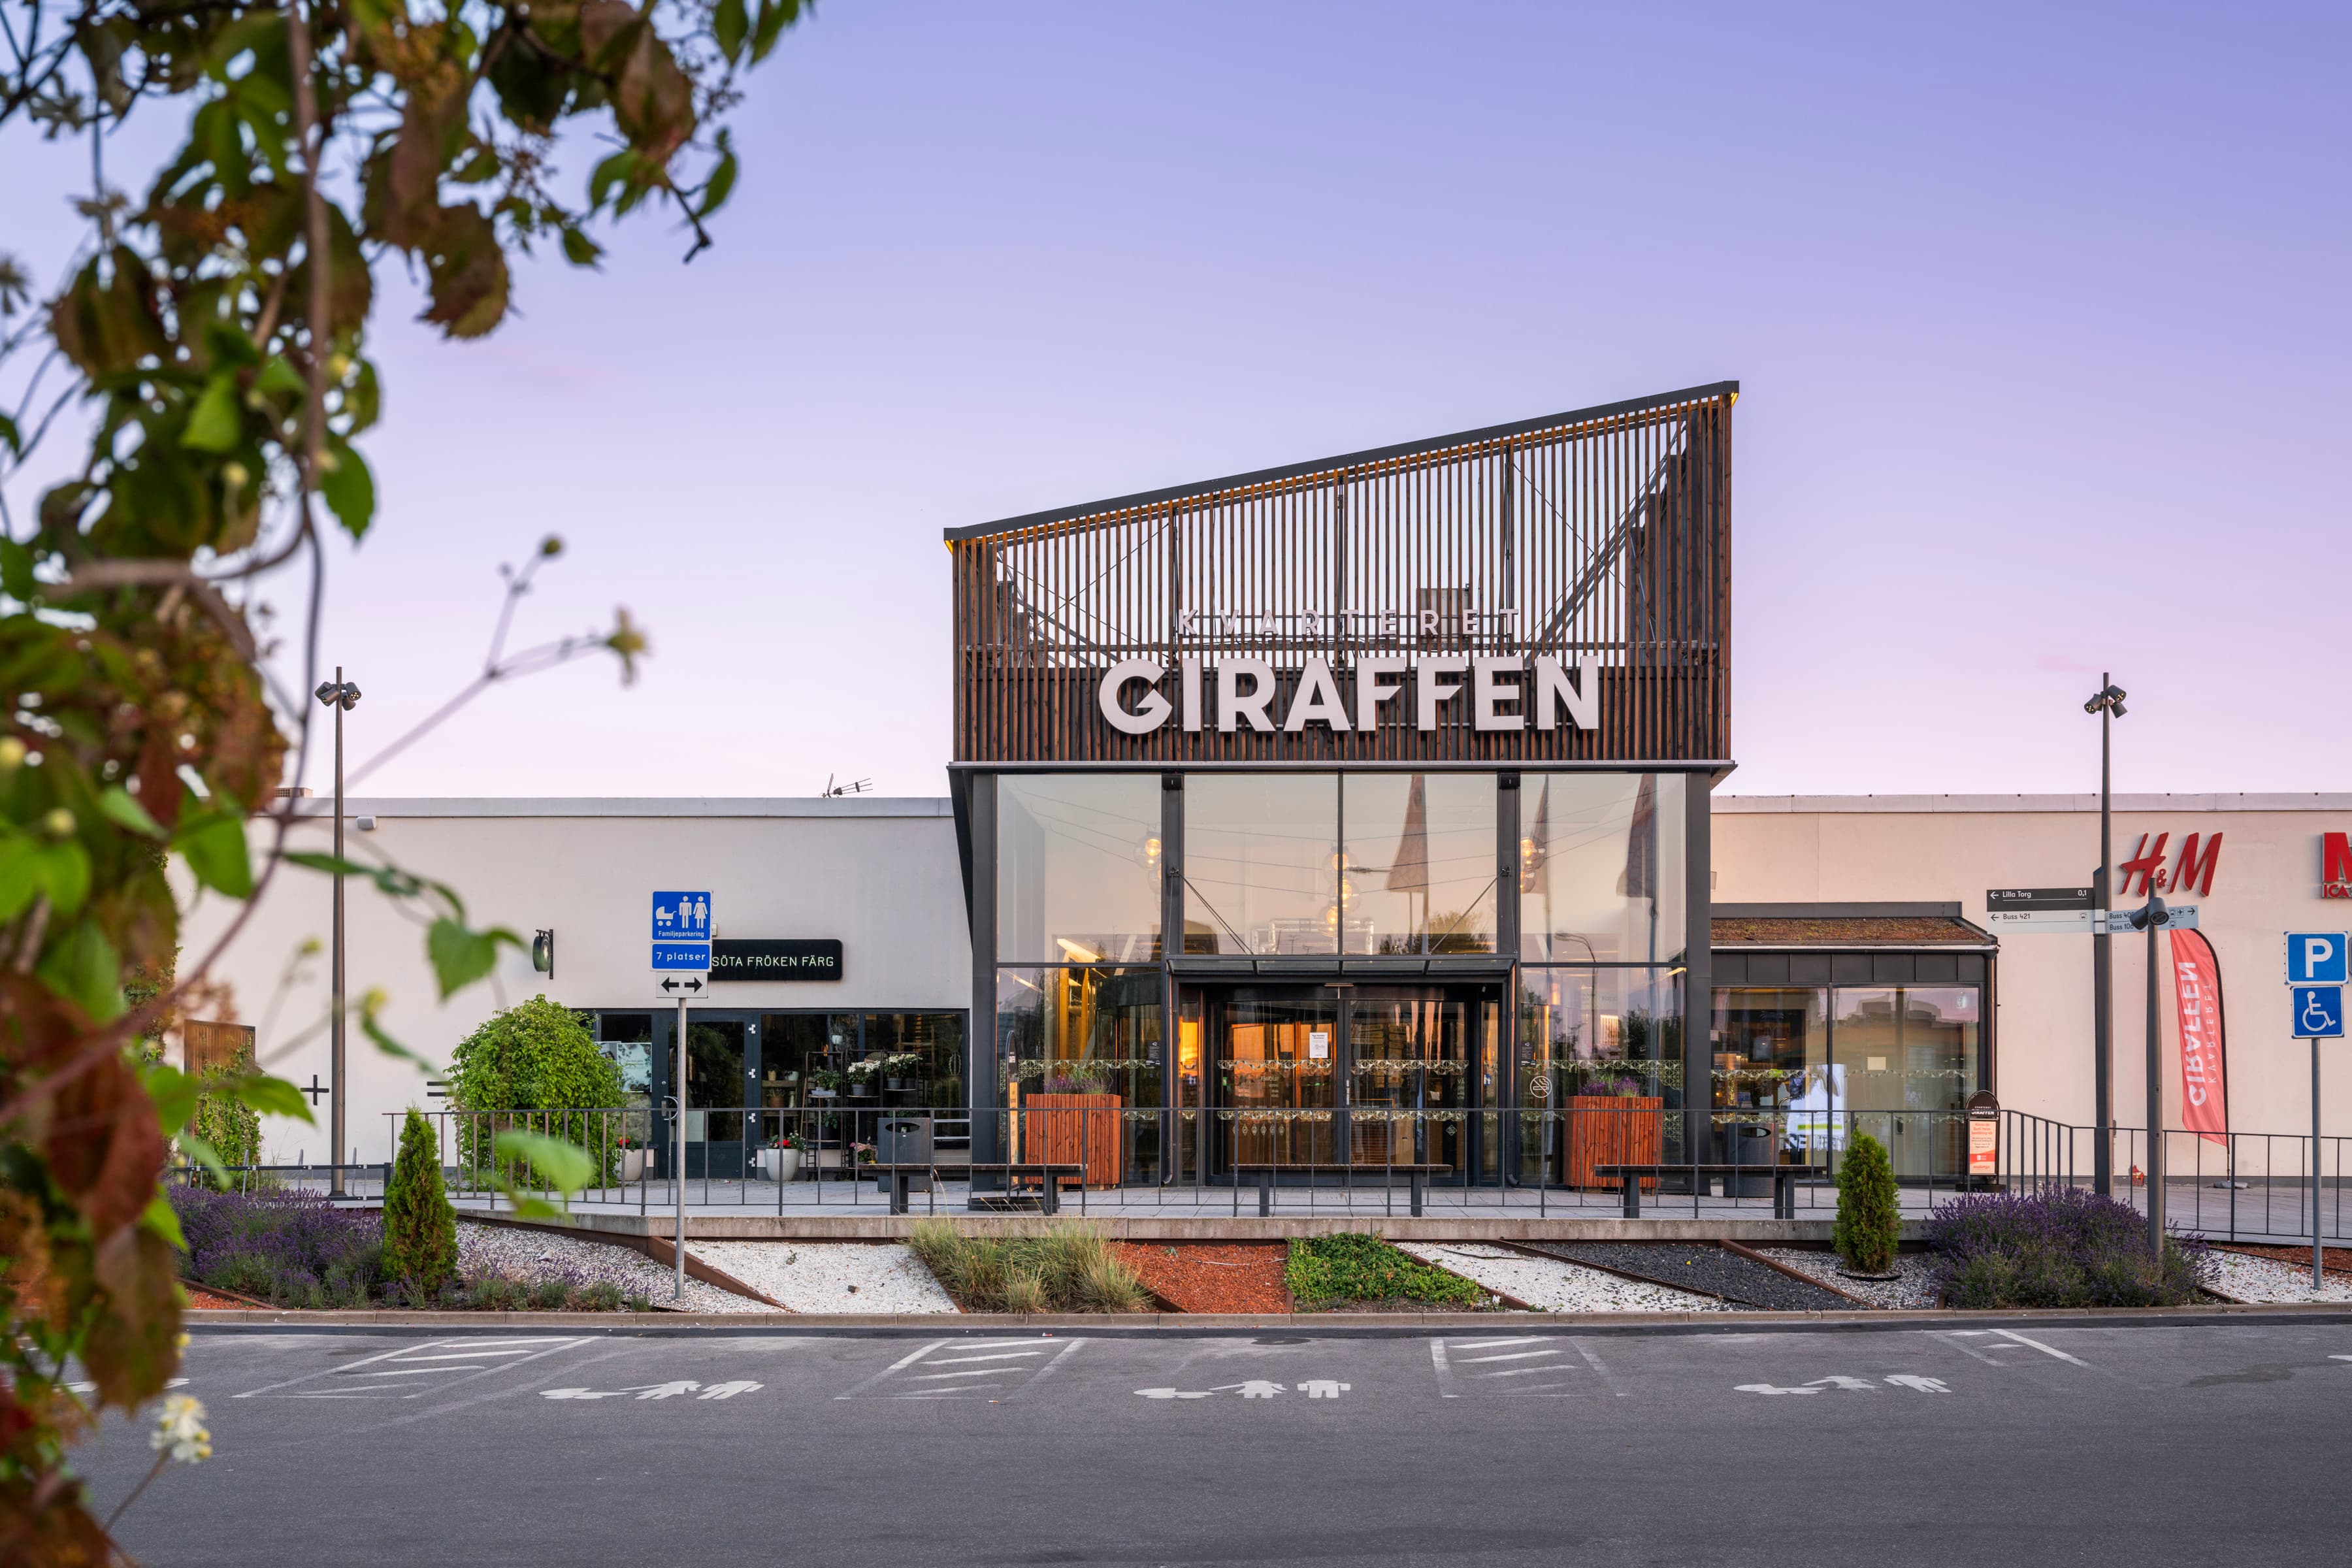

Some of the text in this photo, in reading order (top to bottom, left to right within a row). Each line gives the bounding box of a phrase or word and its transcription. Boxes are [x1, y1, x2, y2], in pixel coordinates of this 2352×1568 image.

[1177, 608, 1519, 636] KVARTERET
[1099, 656, 1598, 734] GIRAFFEN
[2121, 832, 2223, 897] H&M
[2017, 890, 2032, 899] Torg
[656, 952, 706, 962] 7 platser
[711, 955, 834, 967] SÖTA FRÖKEN FÄRG
[2305, 938, 2333, 978] P
